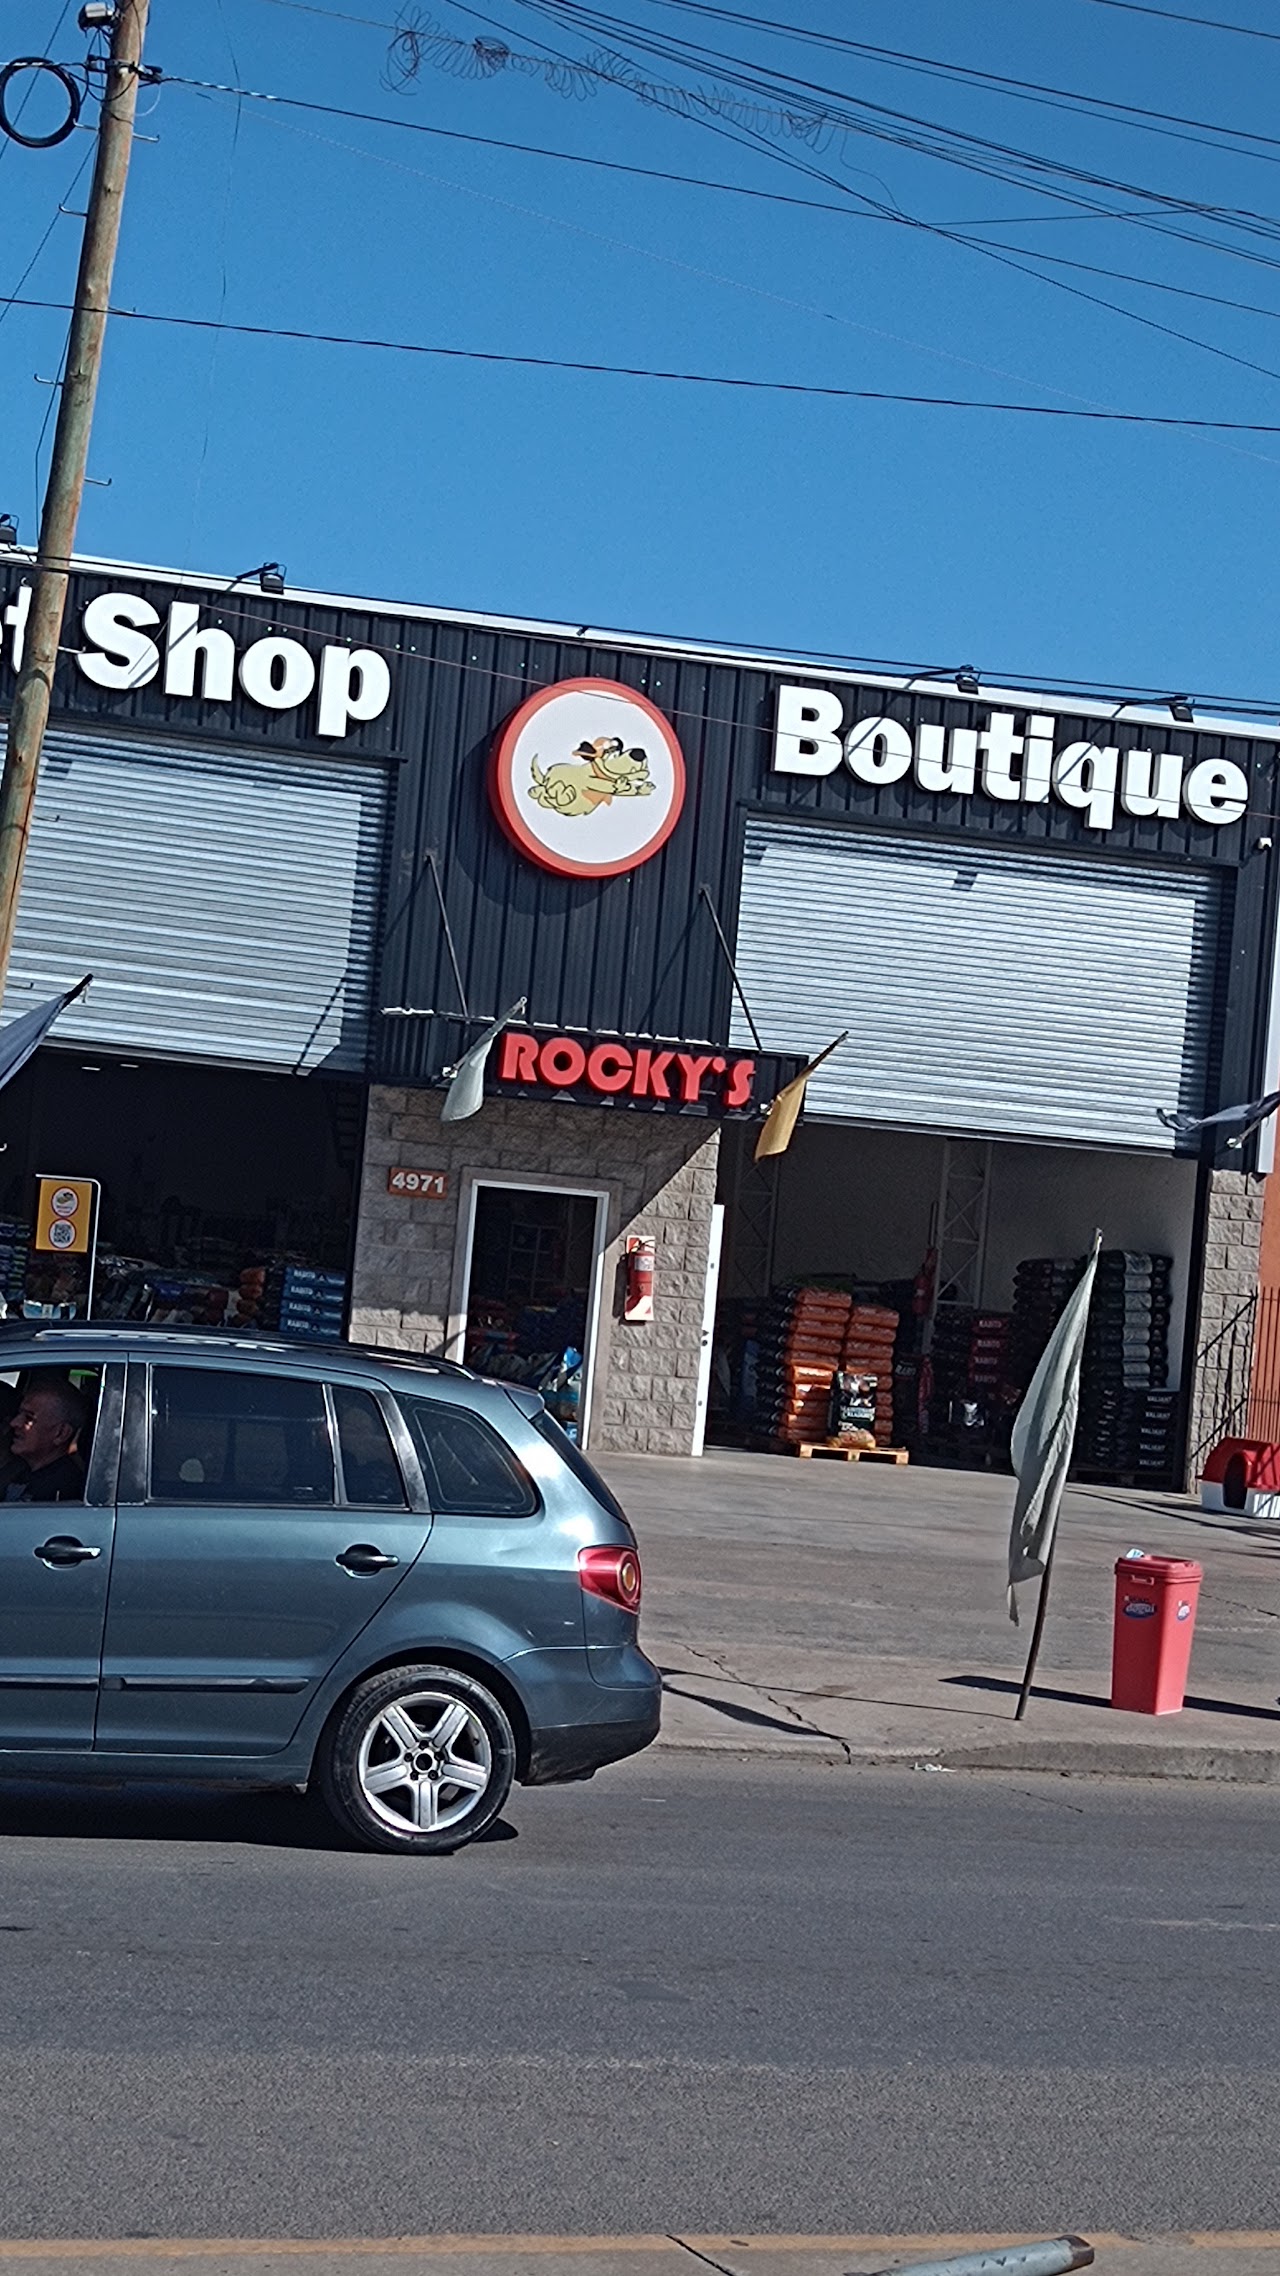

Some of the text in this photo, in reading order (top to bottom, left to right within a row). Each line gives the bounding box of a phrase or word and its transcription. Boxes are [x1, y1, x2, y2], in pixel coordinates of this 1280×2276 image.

[75, 592, 391, 738] Shop
[770, 684, 1249, 831] Boutique
[500, 1032, 755, 1108] ROCKY'S
[392, 1171, 444, 1194] 4971
